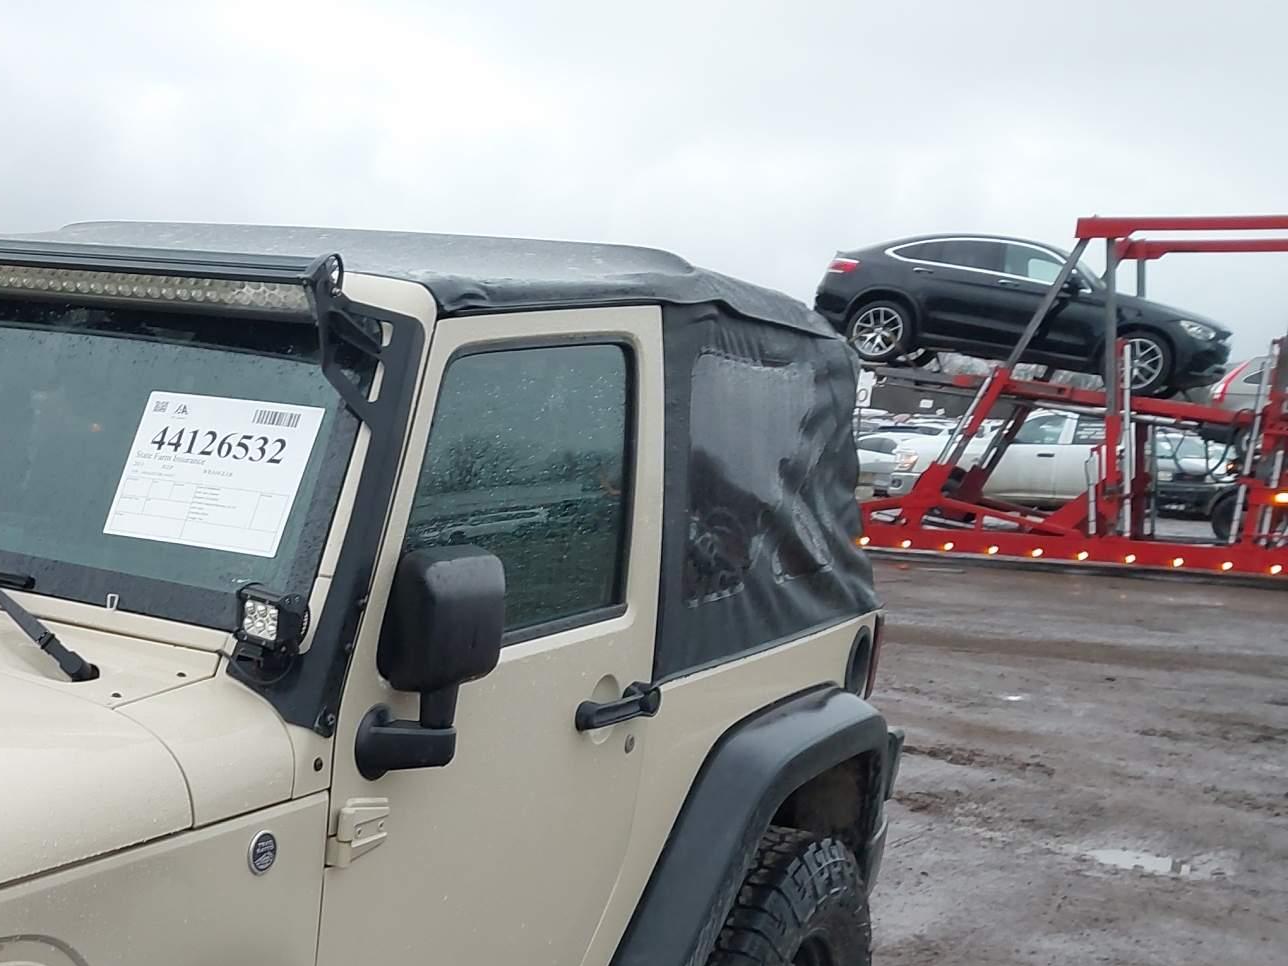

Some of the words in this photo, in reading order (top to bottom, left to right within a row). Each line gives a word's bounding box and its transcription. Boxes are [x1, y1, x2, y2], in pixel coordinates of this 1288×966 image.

[136, 450, 153, 460] State
[153, 452, 172, 462] Farm
[172, 454, 206, 466] Insurance
[150, 426, 287, 464] 44126532
